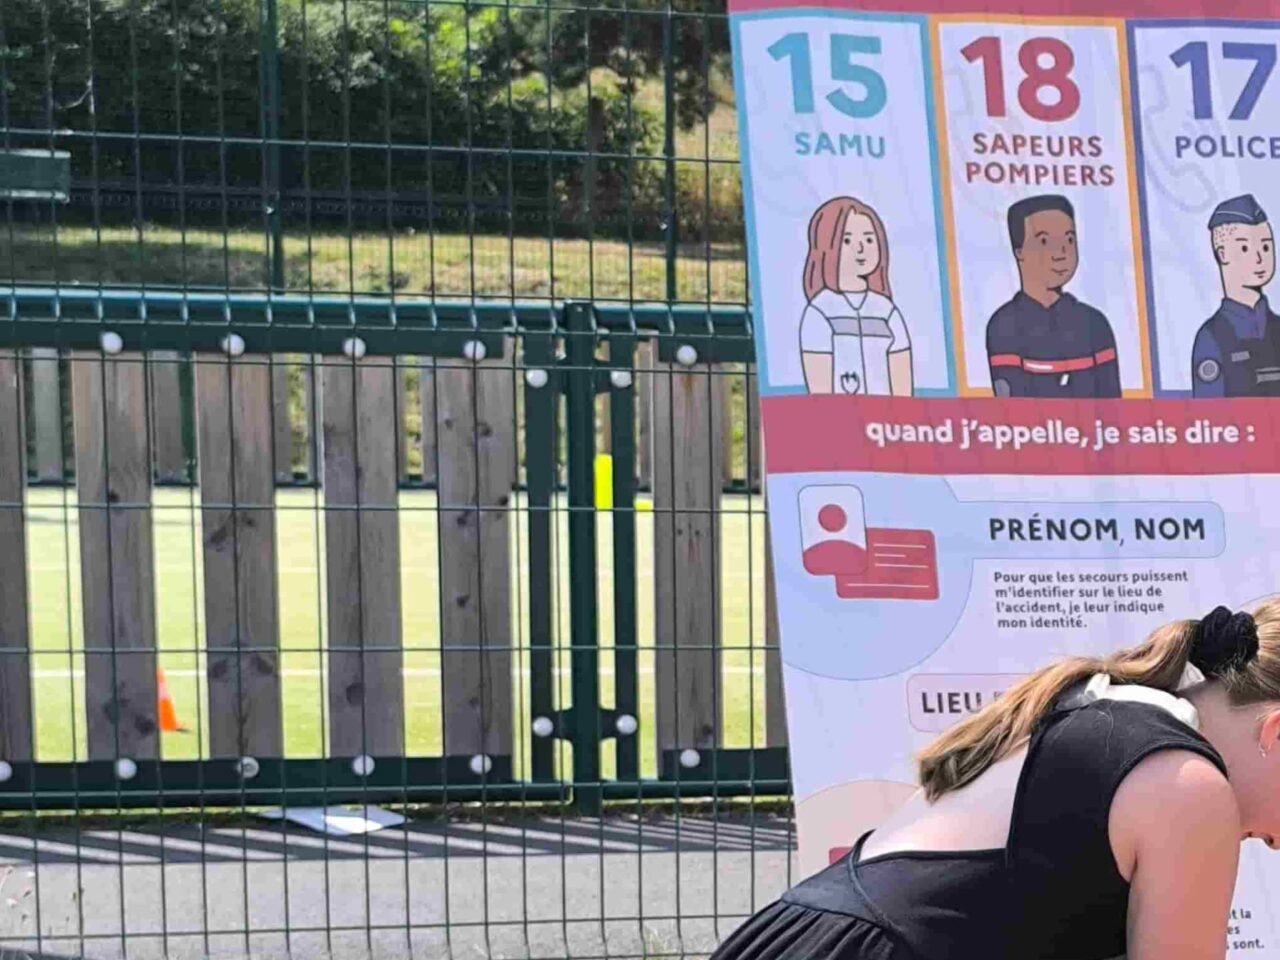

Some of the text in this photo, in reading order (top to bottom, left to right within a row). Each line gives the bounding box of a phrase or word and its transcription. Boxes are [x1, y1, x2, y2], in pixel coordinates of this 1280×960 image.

[767, 33, 887, 119] 15
[959, 36, 1081, 123] 18
[1169, 40, 1278, 121] 17
[795, 132, 887, 160] SAMU
[972, 133, 1103, 160] SAPEURS
[965, 162, 1116, 187] POMPIERS
[866, 419, 953, 446] quand
[961, 419, 1089, 449] j'appelle,
[1093, 420, 1120, 450] je
[1128, 421, 1177, 443] sais
[1185, 420, 1240, 444] dire
[989, 513, 1206, 547] PRÉNOM, NOM
[994, 571, 1188, 585] Pour que les secours puissent
[995, 585, 1162, 598] m'identifier sur le lieu de
[996, 600, 1164, 614] l'accident, je leur indique
[998, 615, 1087, 628] mon identité.
[922, 692, 981, 713] LIEU
